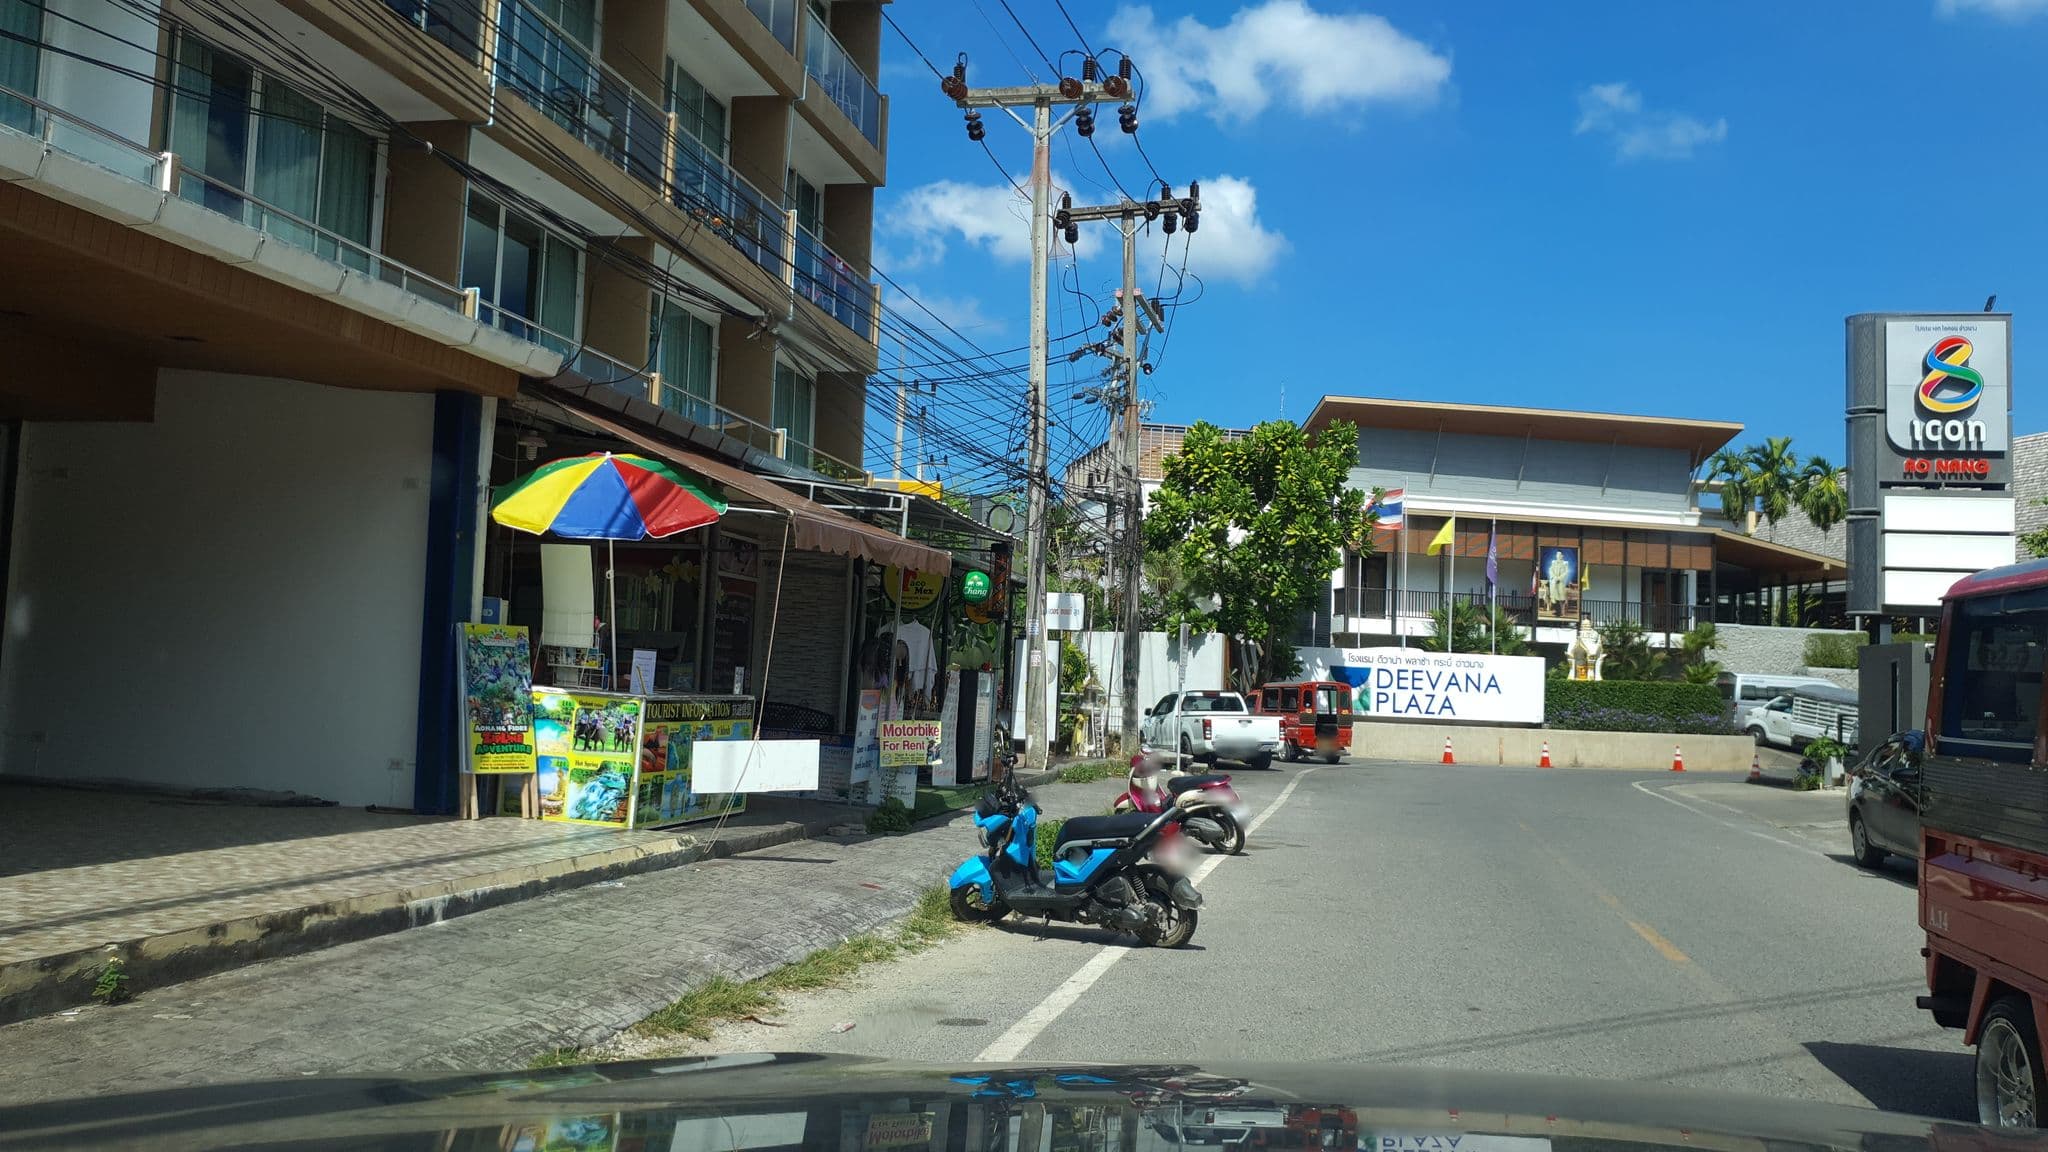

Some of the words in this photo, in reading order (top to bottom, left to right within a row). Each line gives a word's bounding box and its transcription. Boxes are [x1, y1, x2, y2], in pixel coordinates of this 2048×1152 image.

[1912, 419, 1987, 442] icon
[1904, 458, 1931, 474] AO
[1934, 458, 1990, 475] NANG
[914, 586, 934, 595] Mex
[963, 586, 988, 596] Chang
[1376, 668, 1502, 694] DEEVANA
[647, 703, 680, 718] TOURIST
[1376, 692, 1456, 716] PLAZA
[882, 723, 940, 737] Motorbike
[882, 740, 900, 751] For
[902, 740, 925, 751] Rent
